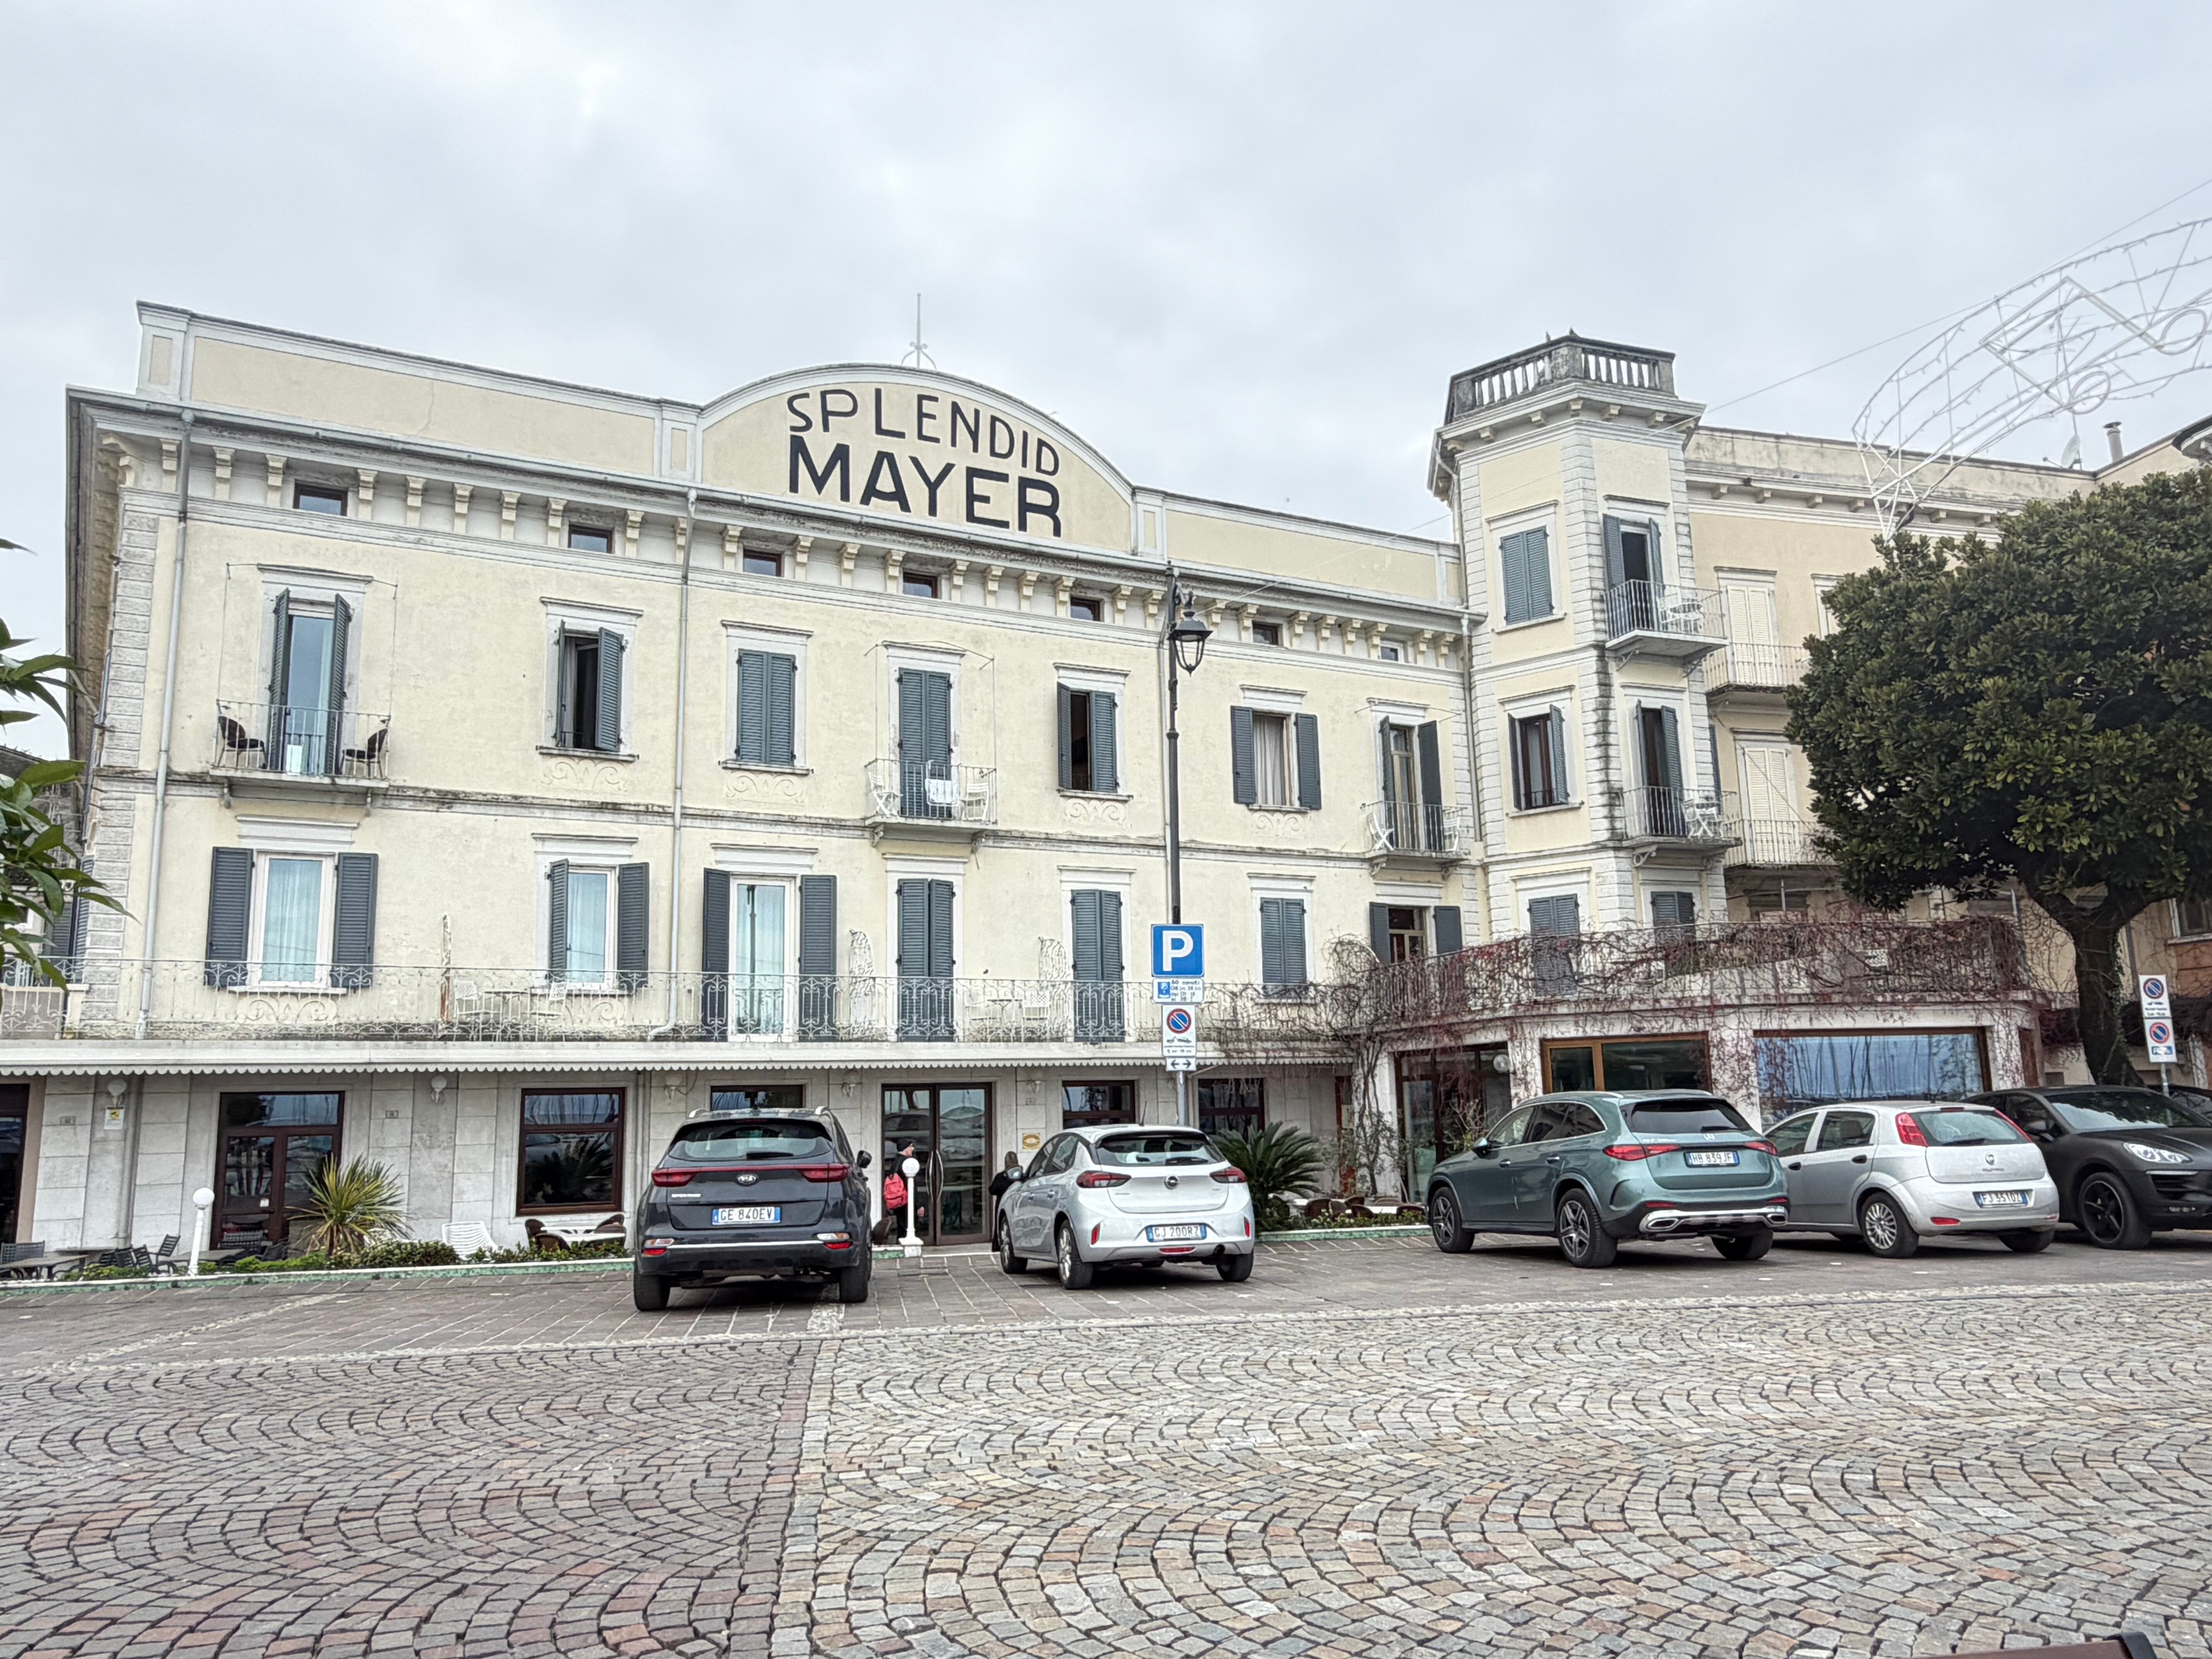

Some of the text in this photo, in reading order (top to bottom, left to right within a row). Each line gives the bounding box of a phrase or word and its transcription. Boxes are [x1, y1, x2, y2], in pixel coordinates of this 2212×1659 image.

[787, 388, 1059, 476] SPLENDID
[789, 434, 1061, 538] MAYER
[1163, 930, 1193, 971] P
